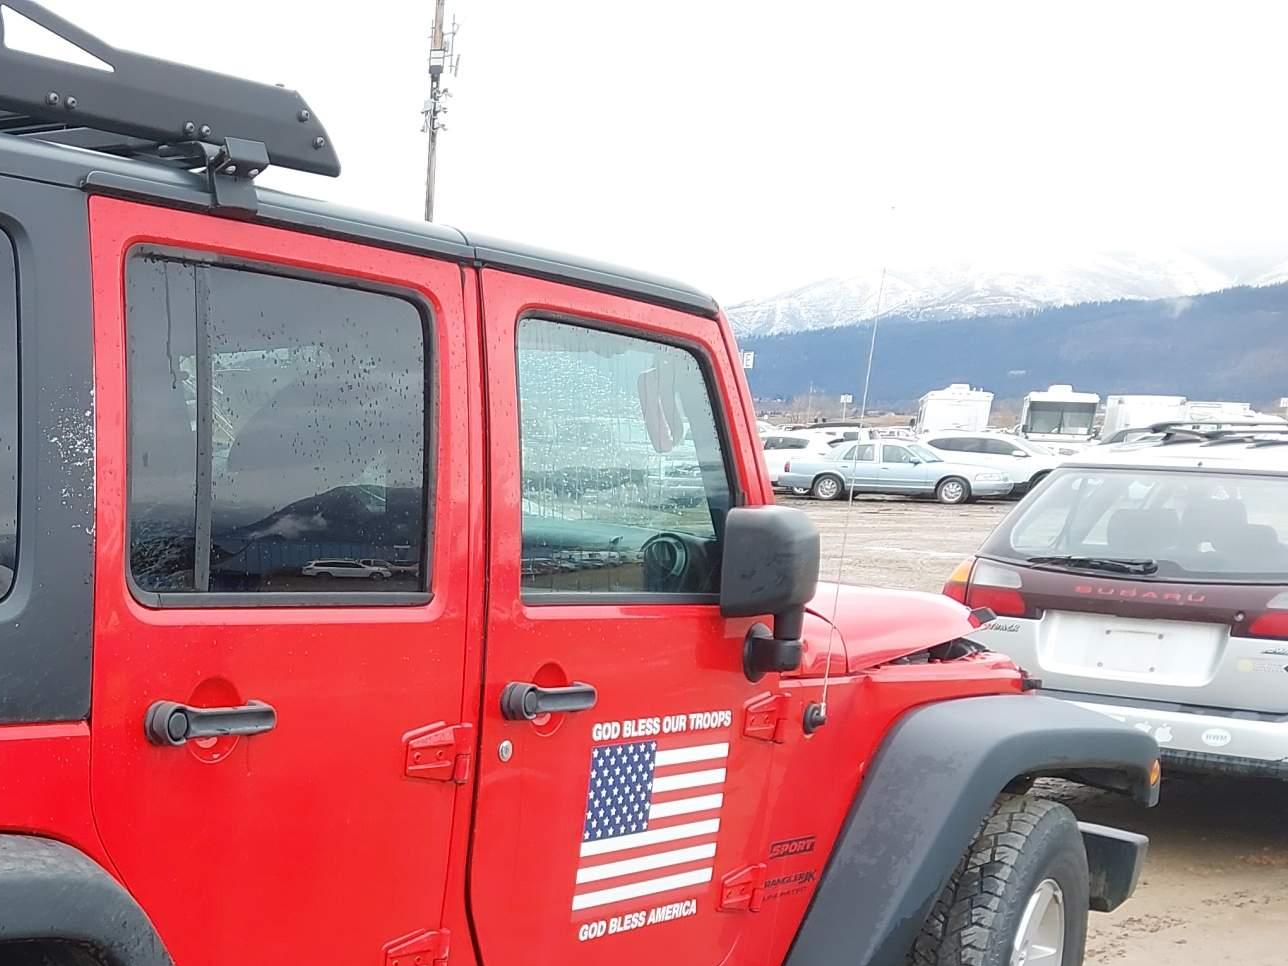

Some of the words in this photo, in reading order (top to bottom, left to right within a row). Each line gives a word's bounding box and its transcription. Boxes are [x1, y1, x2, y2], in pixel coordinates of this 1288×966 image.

[1074, 585, 1206, 602] SUBARU
[592, 722, 620, 741] GOD
[623, 717, 661, 738] BLESS
[663, 714, 687, 733] OUR
[688, 710, 732, 731] TROOPS
[770, 839, 815, 857] SPORT
[578, 920, 607, 941] GOD
[608, 912, 647, 936] BLESS
[647, 899, 697, 926] AMERICA
